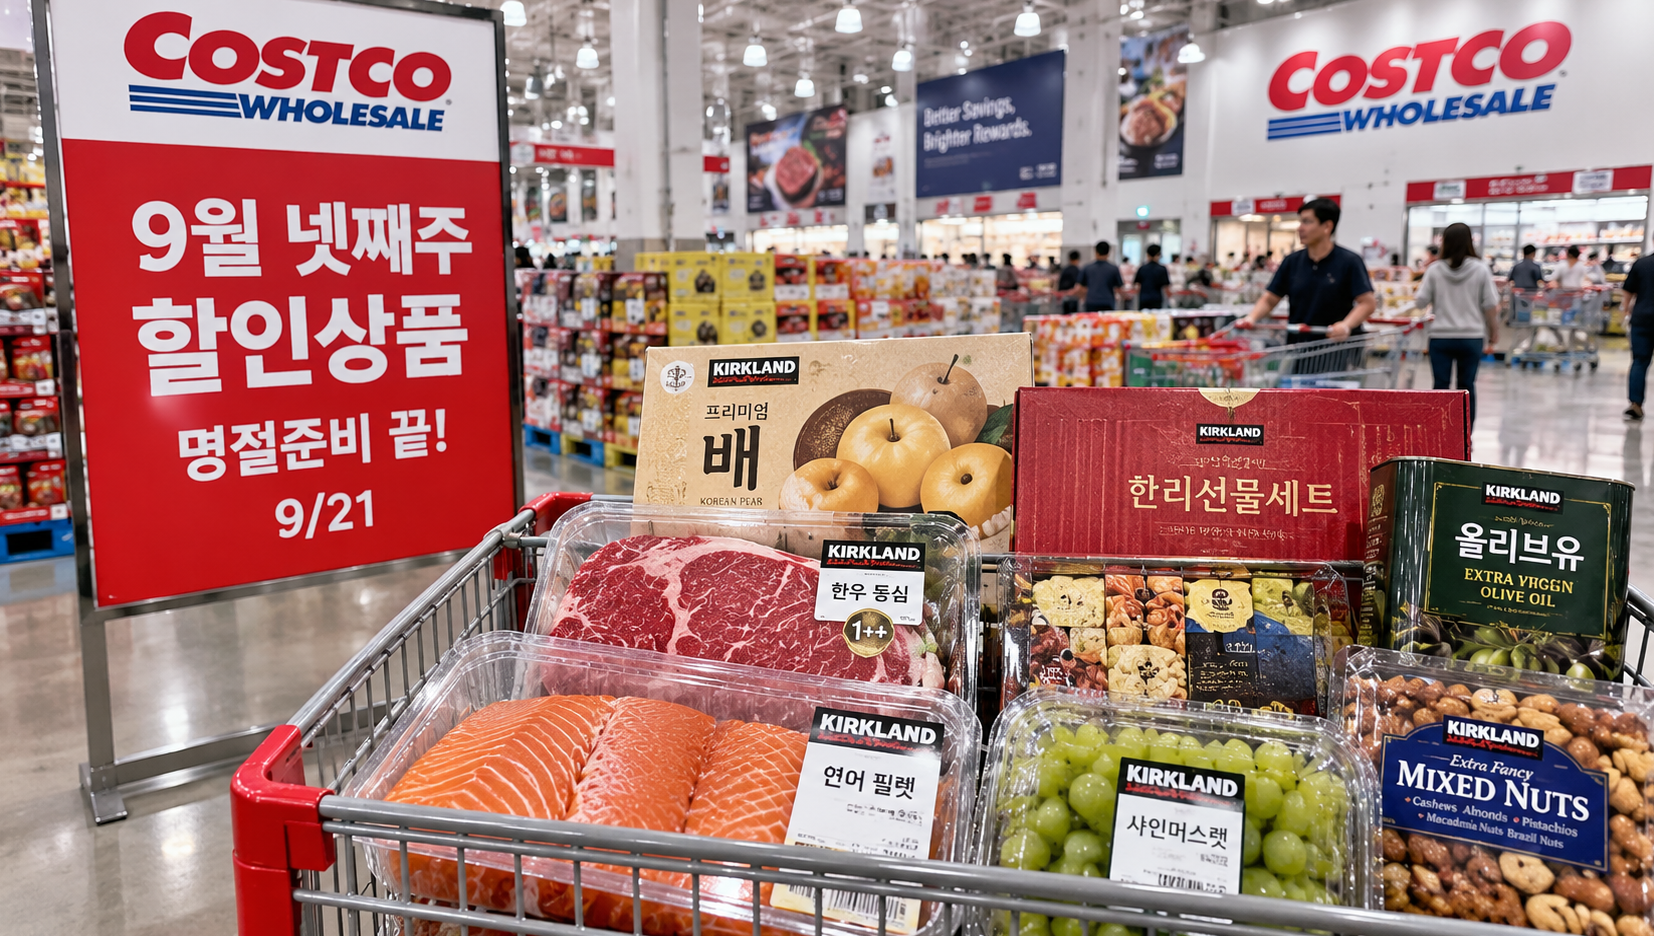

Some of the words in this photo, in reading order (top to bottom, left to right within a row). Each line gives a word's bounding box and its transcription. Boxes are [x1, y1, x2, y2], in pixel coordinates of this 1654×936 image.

[124, 11, 452, 101] COSTCO
[1268, 20, 1572, 111] COSTCO
[239, 94, 445, 132] WHOLESALE
[1341, 84, 1556, 132] WHOLESALE
[132, 198, 262, 277] 9월
[286, 201, 472, 277] 넷째주
[131, 294, 468, 396] 할인상품
[713, 360, 796, 376] KIRKLAND
[704, 402, 768, 421] 프리미엄
[178, 413, 371, 482] 명절준비
[388, 408, 448, 460] 끝!
[1200, 426, 1261, 437] KIRKLAND
[703, 425, 760, 491] 배
[1128, 474, 1338, 517] 한리선물세트
[1485, 484, 1561, 504] KIRKLAND
[275, 490, 374, 540] 9/21
[827, 544, 920, 561] KIRKLAND
[1455, 522, 1584, 572] 올리브유
[831, 582, 866, 601] 한우
[1464, 568, 1514, 586] EXTRA
[1480, 586, 1525, 603] OLIVE
[1529, 593, 1556, 608] OIL
[851, 620, 888, 641] 1++
[819, 713, 936, 745] KIRKLAND
[1447, 720, 1540, 748] KIRKLAND
[824, 765, 865, 792] 연어
[1126, 764, 1238, 797] KIRKLAND
[1450, 754, 1488, 772] Extra
[1491, 761, 1534, 782] Fancy
[1396, 760, 1496, 802] MIXED
[1504, 779, 1590, 822] NUTS
[1412, 796, 1457, 813] Cashews
